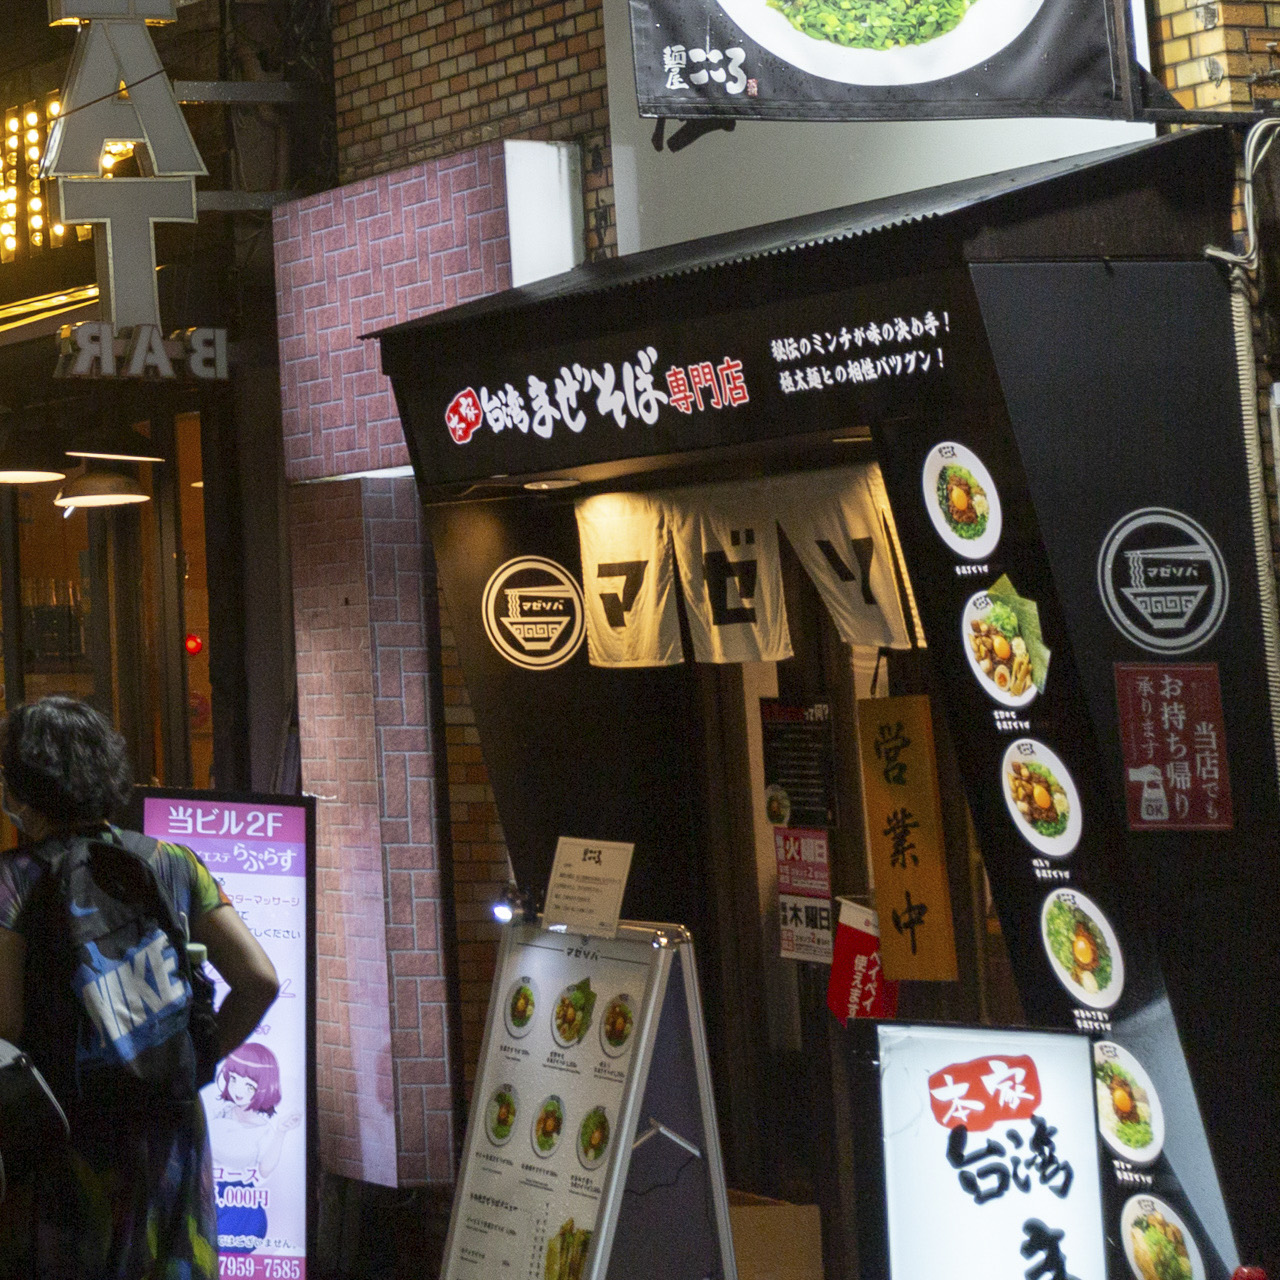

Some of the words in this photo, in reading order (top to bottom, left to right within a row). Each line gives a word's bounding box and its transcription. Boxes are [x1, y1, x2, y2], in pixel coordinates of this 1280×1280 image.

[771, 310, 950, 363] 秘伝のミンチが味の決め手！
[480, 346, 669, 439] 台湾まぜそば
[665, 356, 750, 414] 専門店
[779, 347, 944, 395] 極太麺との相性バツグン！
[1146, 564, 1199, 578] マゼソバ
[522, 598, 565, 611] マゼソバ
[1137, 675, 1160, 759] 承ります
[1160, 673, 1191, 818] お持ち帰り
[1194, 720, 1220, 819] 当店でも
[167, 805, 283, 837] 当ビル2F
[1146, 804, 1164, 816] OK
[196, 850, 231, 863] エステ
[233, 842, 298, 873] らぷらす
[874, 722, 928, 956] 営業中
[249, 927, 301, 940] しください
[83, 936, 189, 1051] NIKE
[930, 1060, 1035, 1123] 本家
[946, 1114, 1075, 1205] 台湾
[215, 1188, 269, 1208] ,000円
